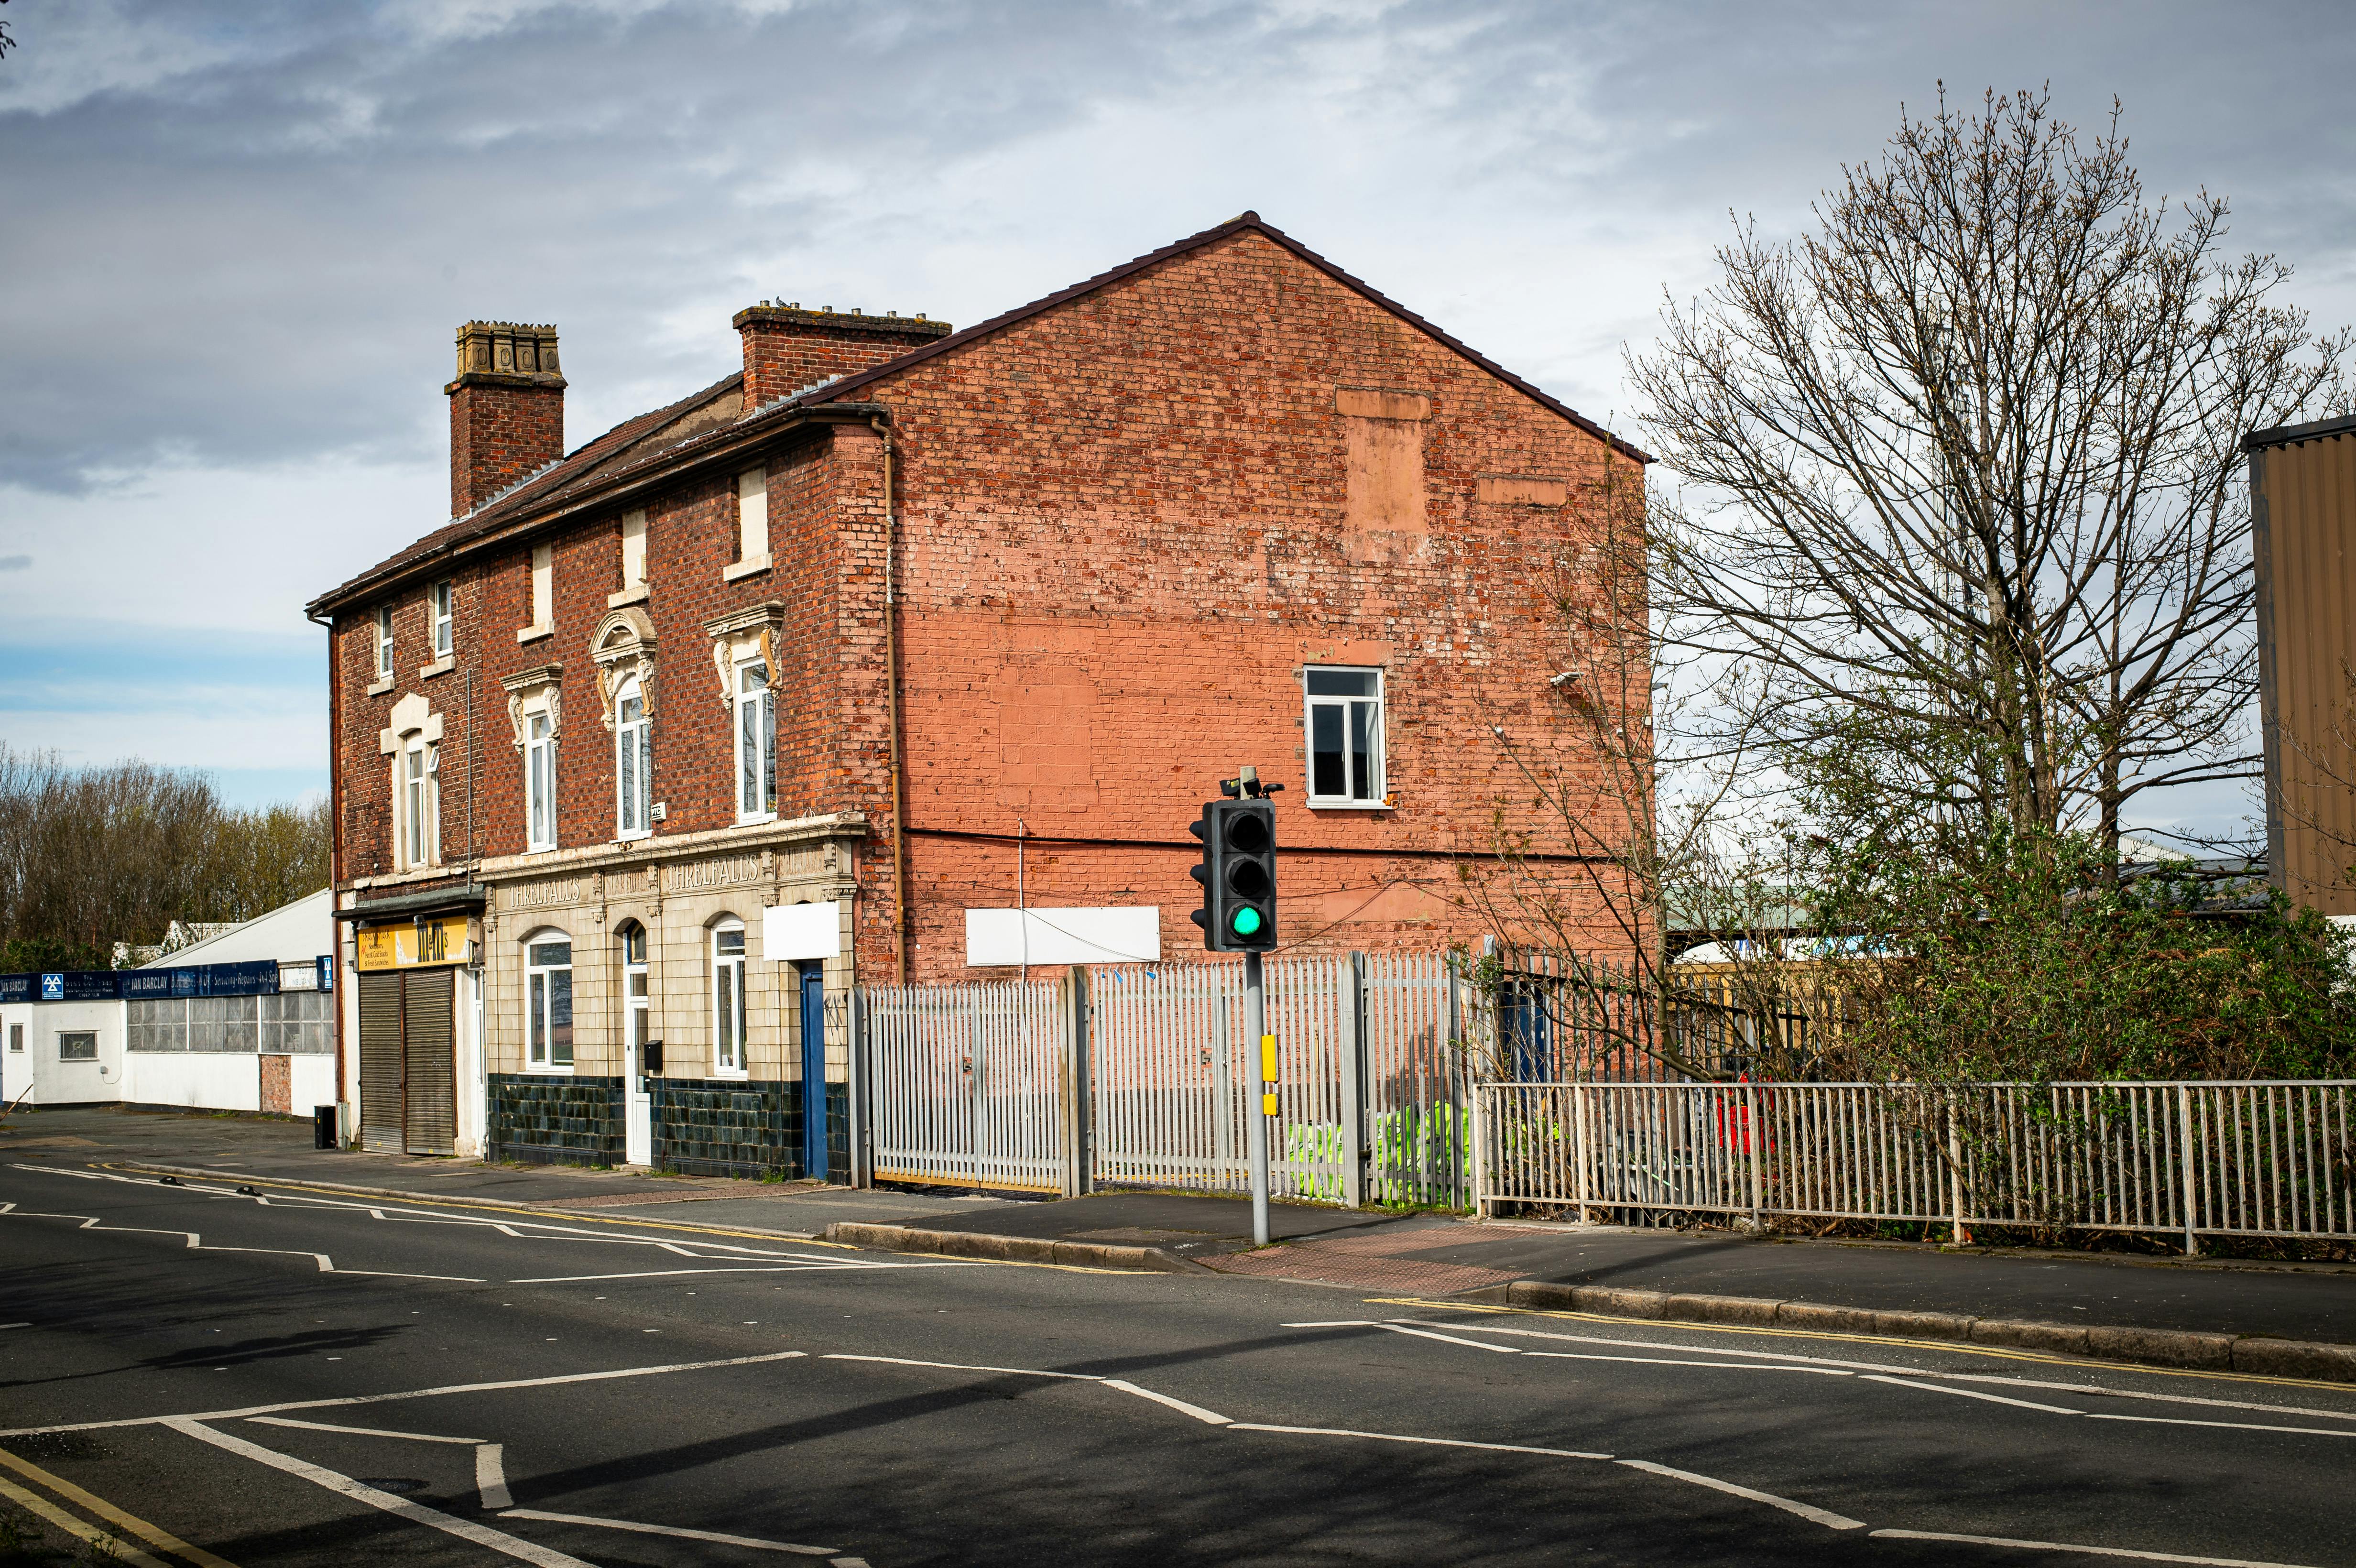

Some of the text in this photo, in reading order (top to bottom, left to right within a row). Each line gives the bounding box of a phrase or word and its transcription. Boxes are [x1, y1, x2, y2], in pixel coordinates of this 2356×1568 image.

[666, 852, 759, 890] THRELFALL'S
[509, 875, 580, 907] THRELFALL'S
[9, 980, 27, 992] BARCLAY
[131, 977, 142, 991] IAN
[143, 976, 168, 990] BARCLAY
[238, 972, 256, 986] Repairs
